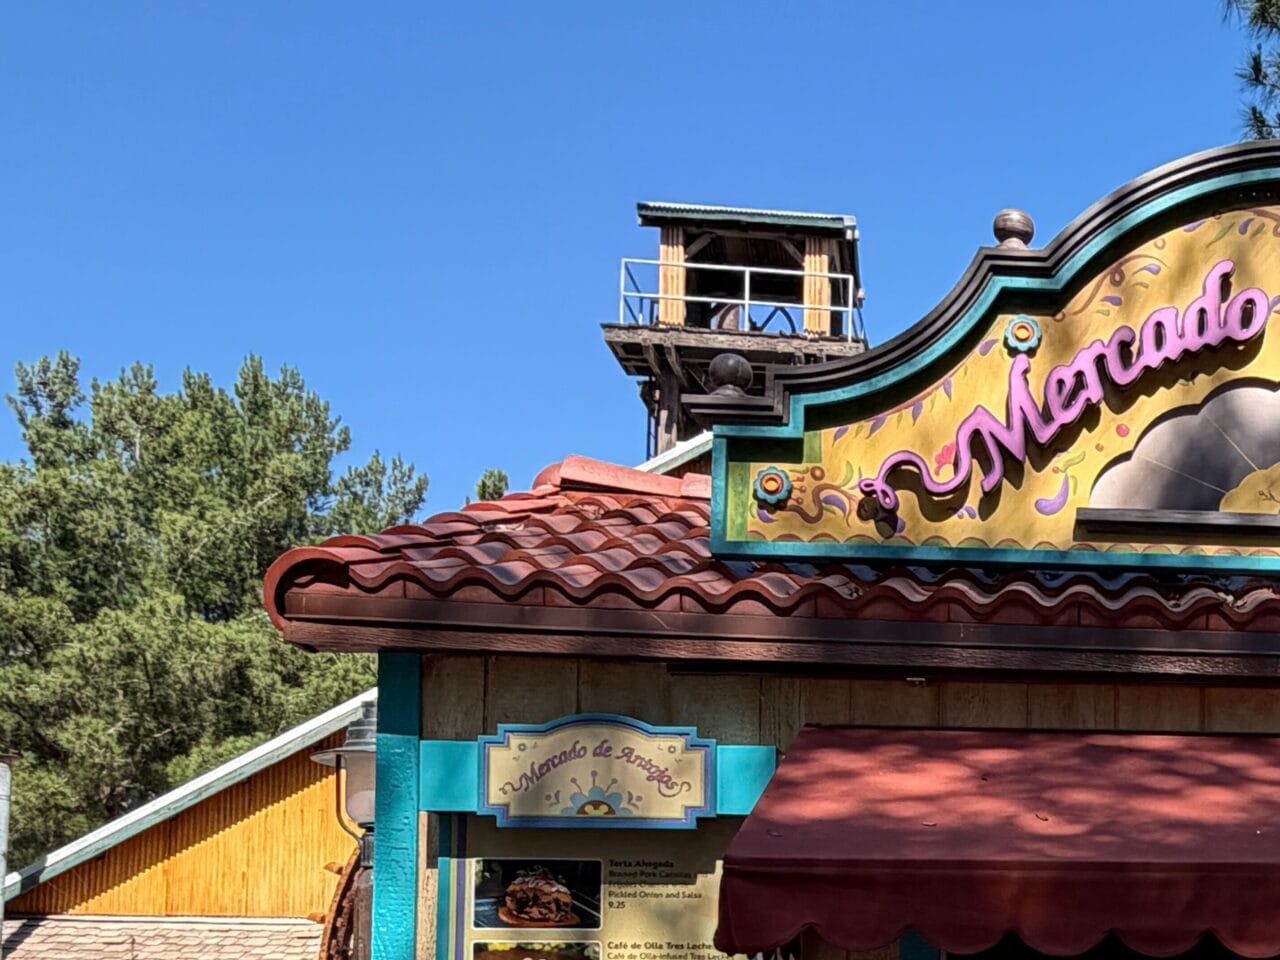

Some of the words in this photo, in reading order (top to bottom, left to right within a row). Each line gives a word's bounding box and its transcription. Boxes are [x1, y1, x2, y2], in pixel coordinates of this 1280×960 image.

[860, 259, 1269, 513] Mercado
[499, 740, 587, 795] Mercado
[593, 740, 613, 758] de
[615, 746, 691, 797] Antojos
[666, 942, 684, 950] Tres
